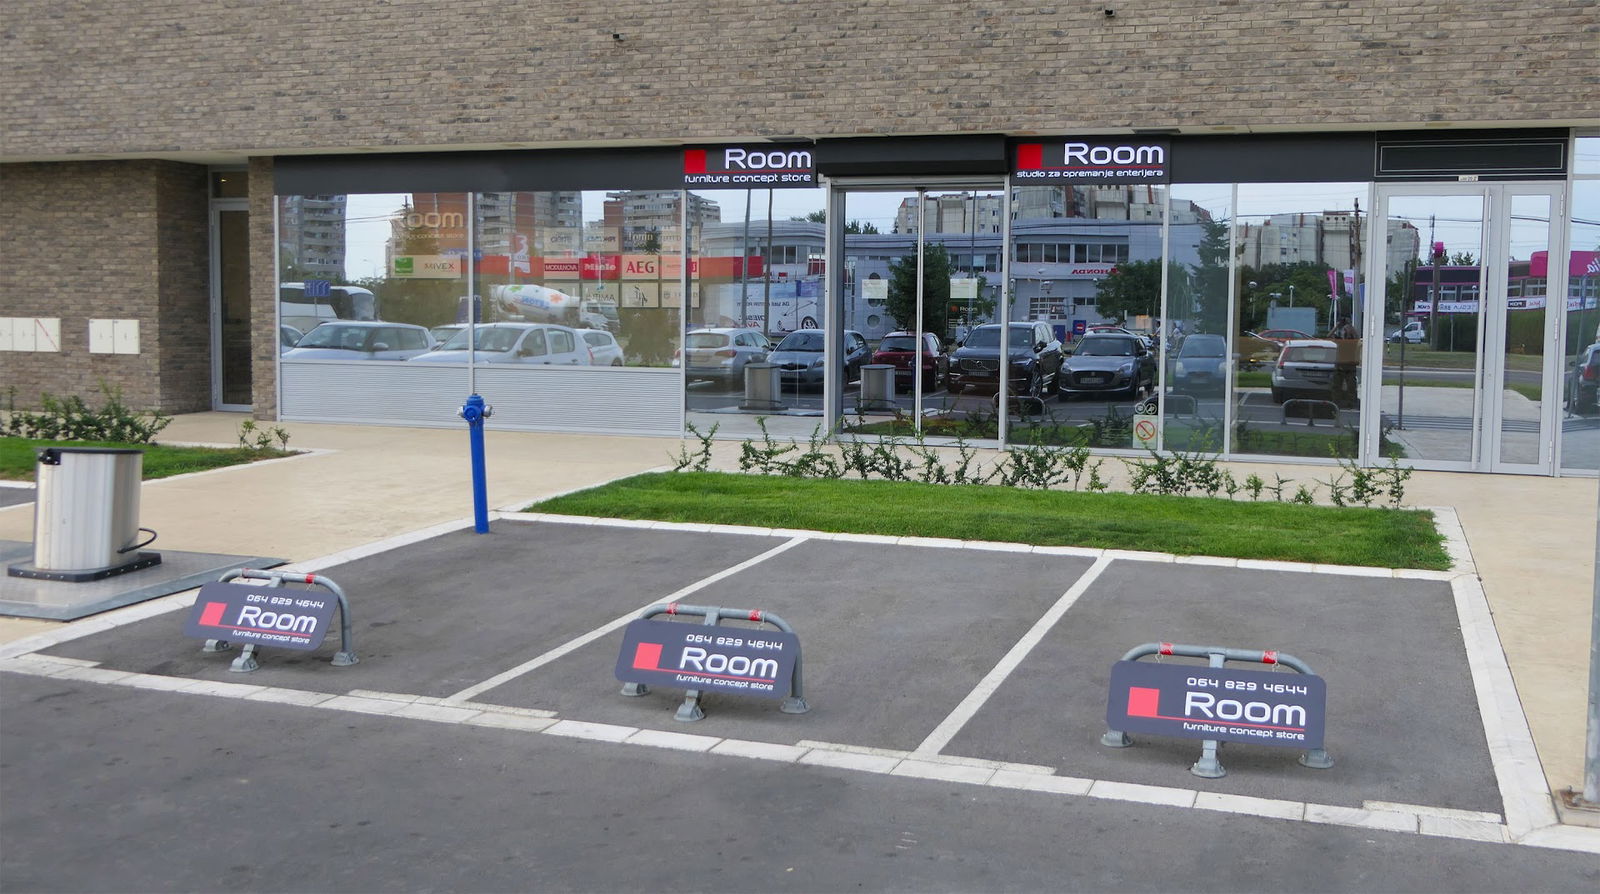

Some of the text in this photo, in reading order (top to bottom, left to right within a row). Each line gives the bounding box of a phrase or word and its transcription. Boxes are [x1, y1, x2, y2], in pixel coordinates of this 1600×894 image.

[725, 149, 811, 169] Room
[1064, 143, 1164, 165] Room
[685, 173, 811, 183] furniture concept store
[1017, 170, 1045, 178] studio
[1063, 170, 1114, 179] opremanje
[1116, 169, 1164, 178] enterijera
[626, 261, 655, 274] AEG
[246, 594, 325, 609] 064 829 4644
[237, 605, 317, 633] Room
[232, 629, 310, 644] furniture concept store
[686, 634, 783, 651] 064 829 4644
[679, 646, 778, 678] Room
[676, 674, 774, 690] furniture concept store
[1187, 677, 1307, 696] 064 829 4644
[1184, 691, 1306, 726] Room
[1183, 722, 1305, 741] furniture concept store
